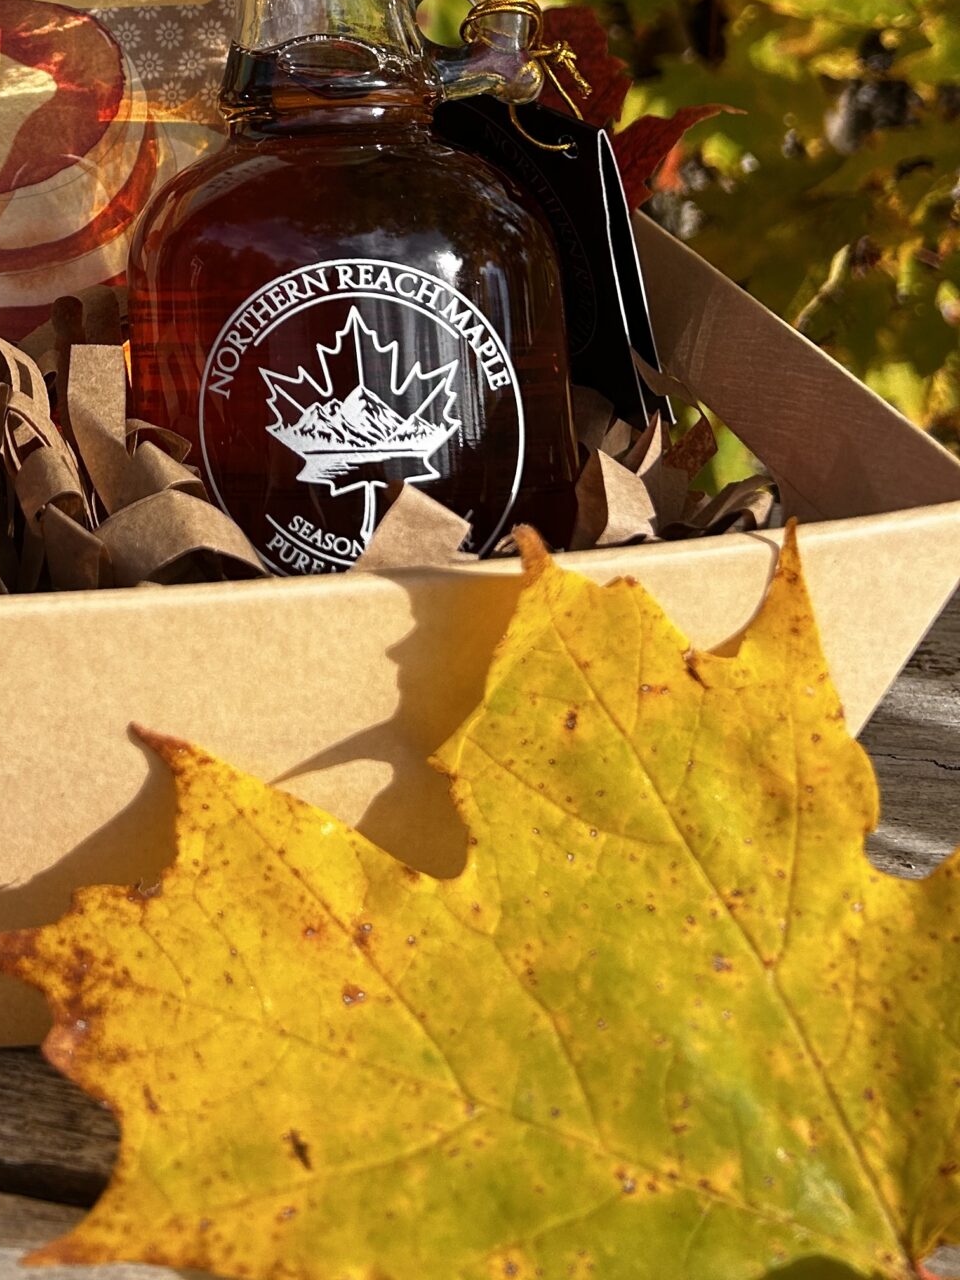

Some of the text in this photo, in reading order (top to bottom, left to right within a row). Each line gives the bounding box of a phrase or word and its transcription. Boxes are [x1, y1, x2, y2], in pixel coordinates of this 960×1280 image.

[208, 267, 330, 400] NORTHERN
[337, 264, 442, 308] REACH
[438, 296, 512, 392] MAPLE
